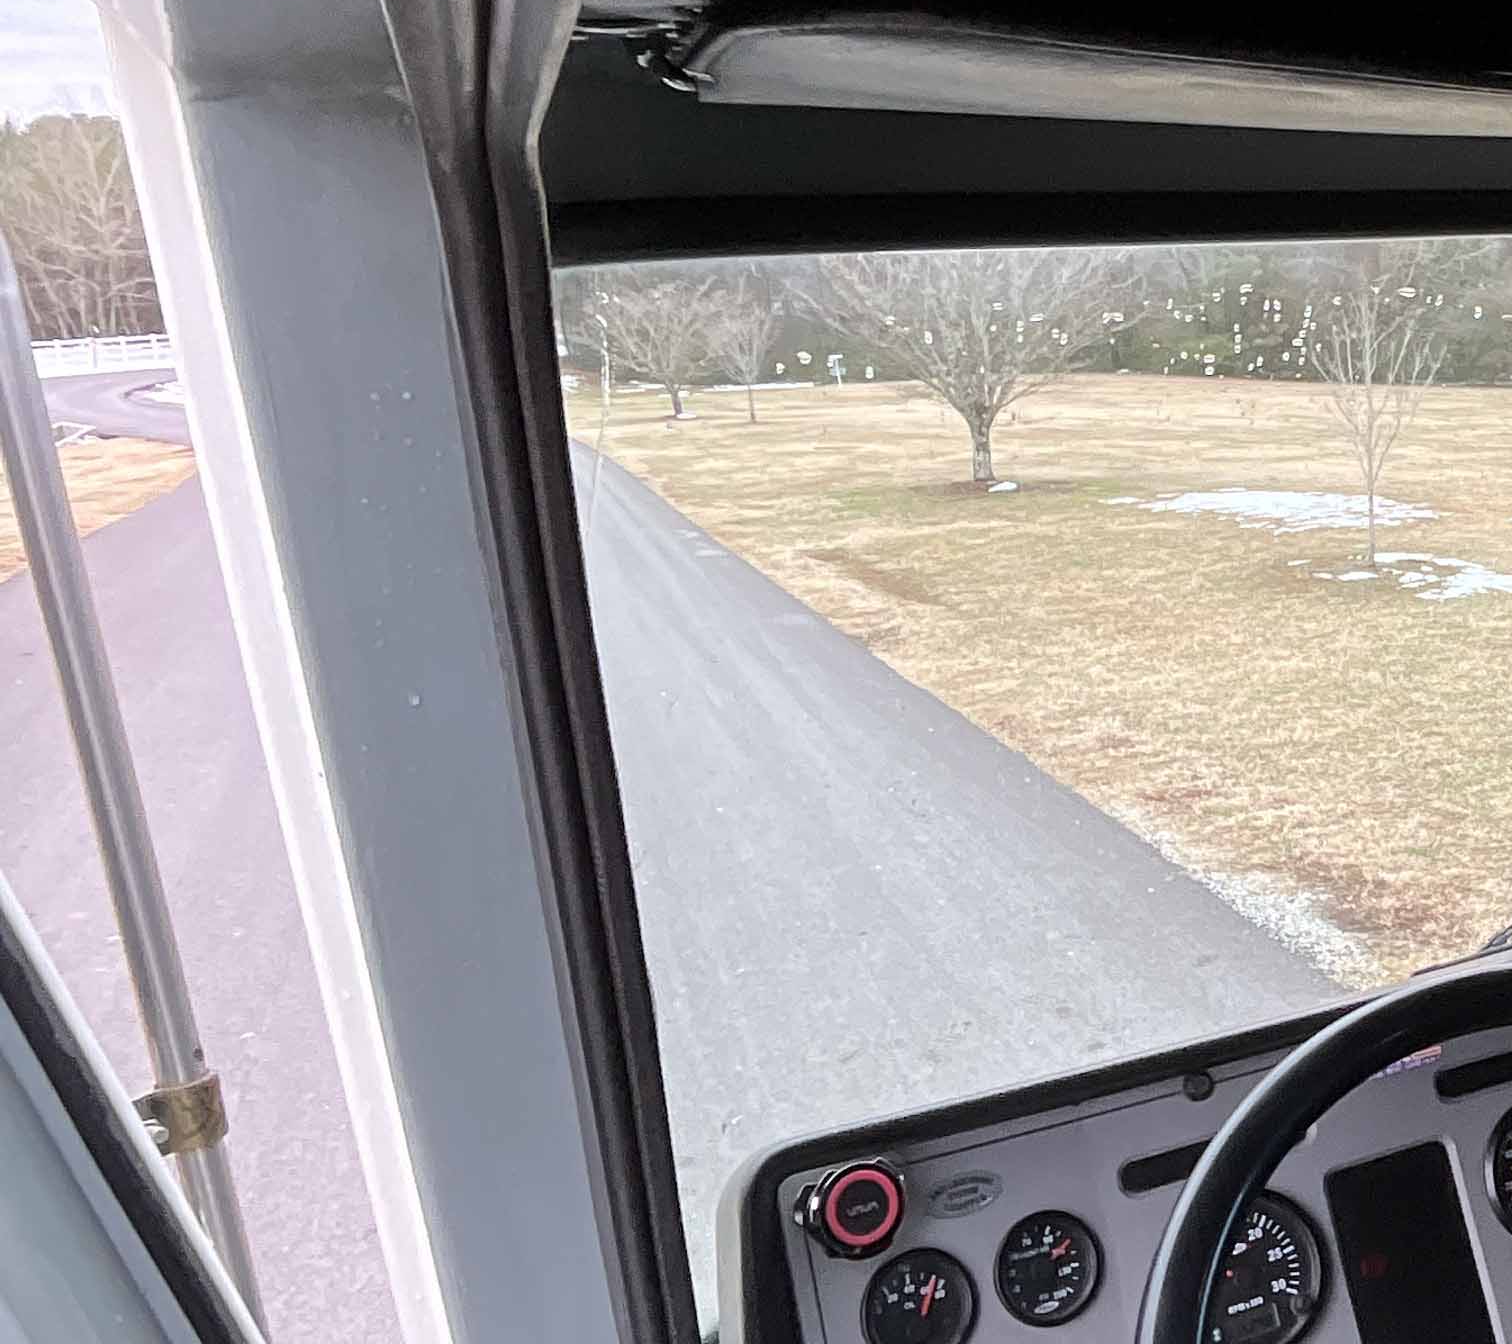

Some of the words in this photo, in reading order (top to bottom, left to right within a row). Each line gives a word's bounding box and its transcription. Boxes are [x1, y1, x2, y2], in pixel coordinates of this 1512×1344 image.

[1248, 1227, 1263, 1241] 20
[1267, 1247, 1283, 1262] 25
[1271, 1278, 1287, 1293] 30
